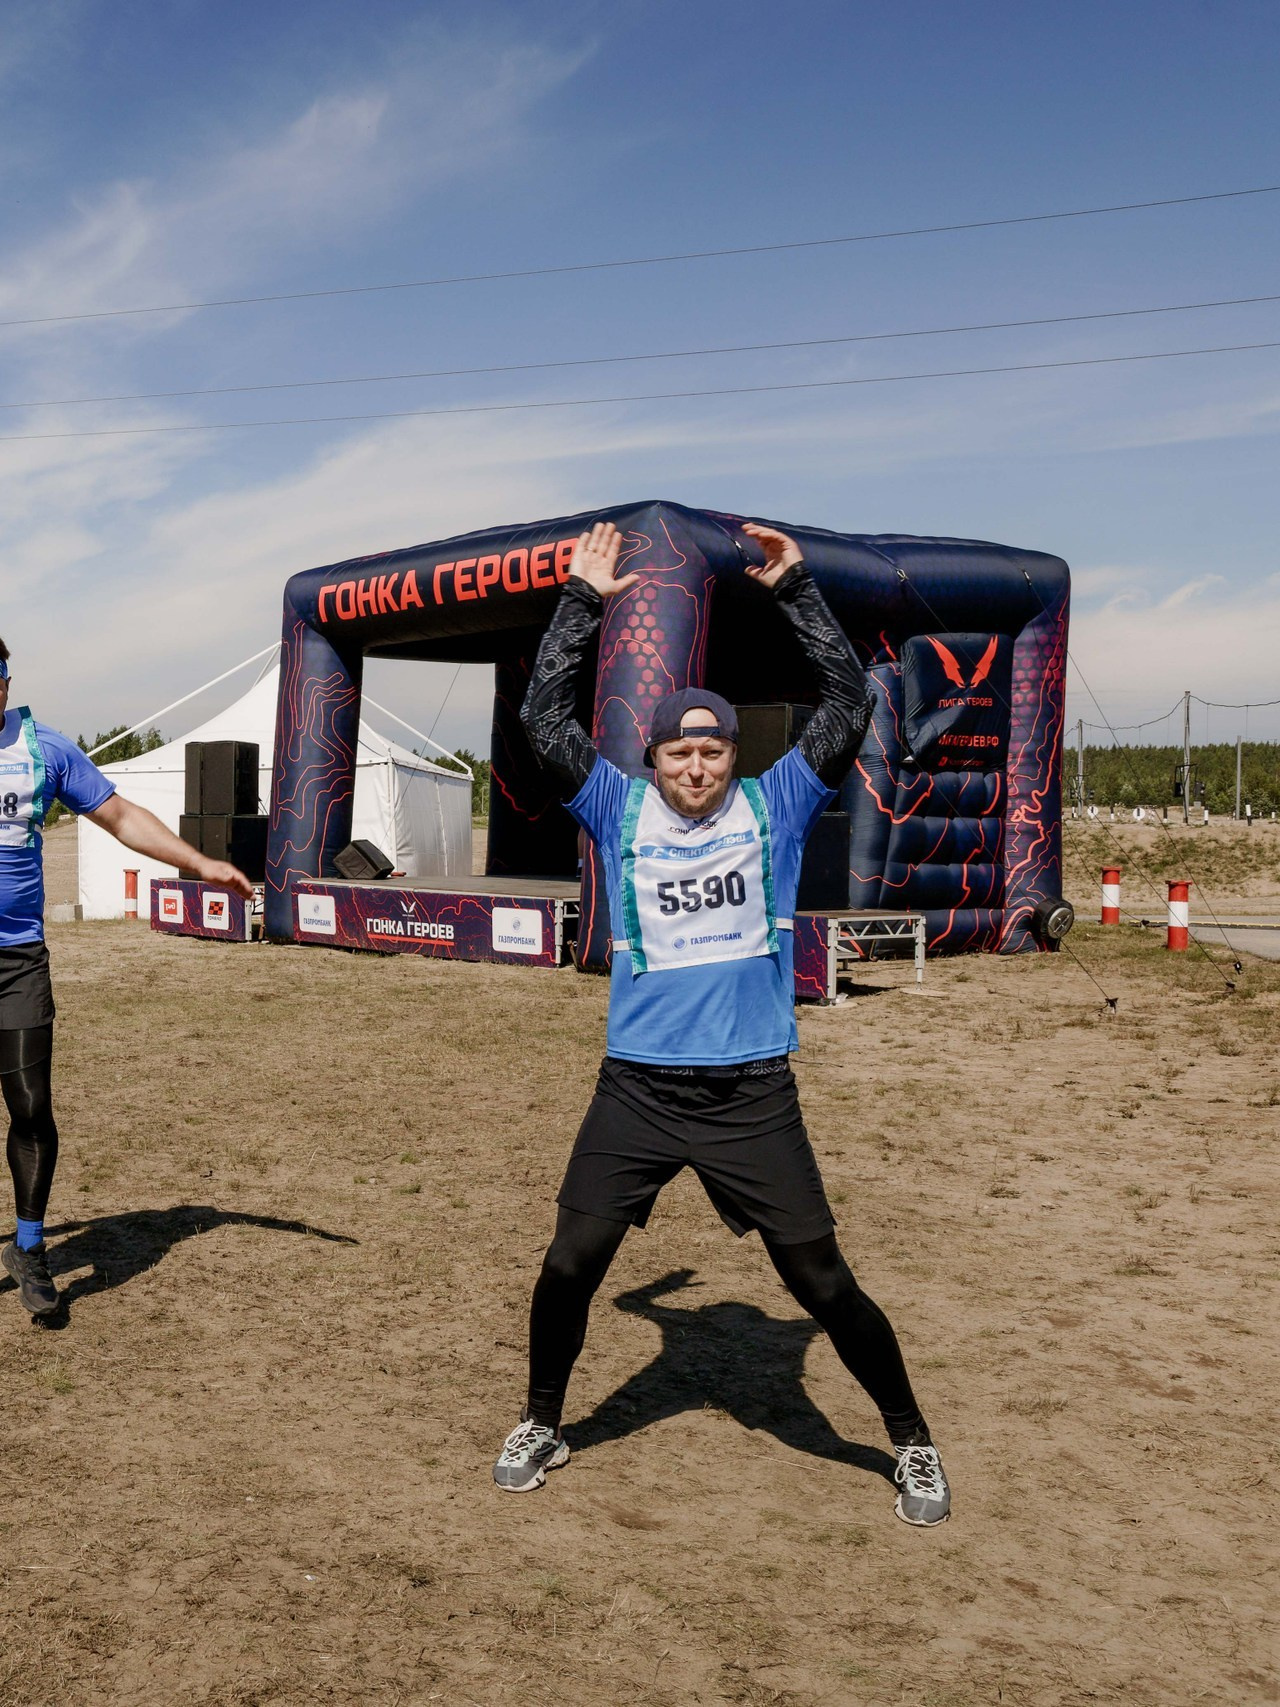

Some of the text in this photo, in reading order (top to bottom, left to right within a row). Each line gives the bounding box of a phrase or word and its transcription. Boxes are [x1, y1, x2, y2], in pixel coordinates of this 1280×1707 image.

[318, 537, 581, 623] ГОНКА ГЕРОЕВ
[939, 697, 993, 708] ЛИГА ГЕРОЕВ
[657, 870, 746, 916] 5590
[303, 917, 332, 927] ГАЗПРОМБАНК
[366, 918, 455, 940] ГОНКА ГЕРОЕВ
[498, 935, 536, 946] ГАЗПРОМБАНК
[690, 932, 743, 946] ГАЗПРОМБАНК
